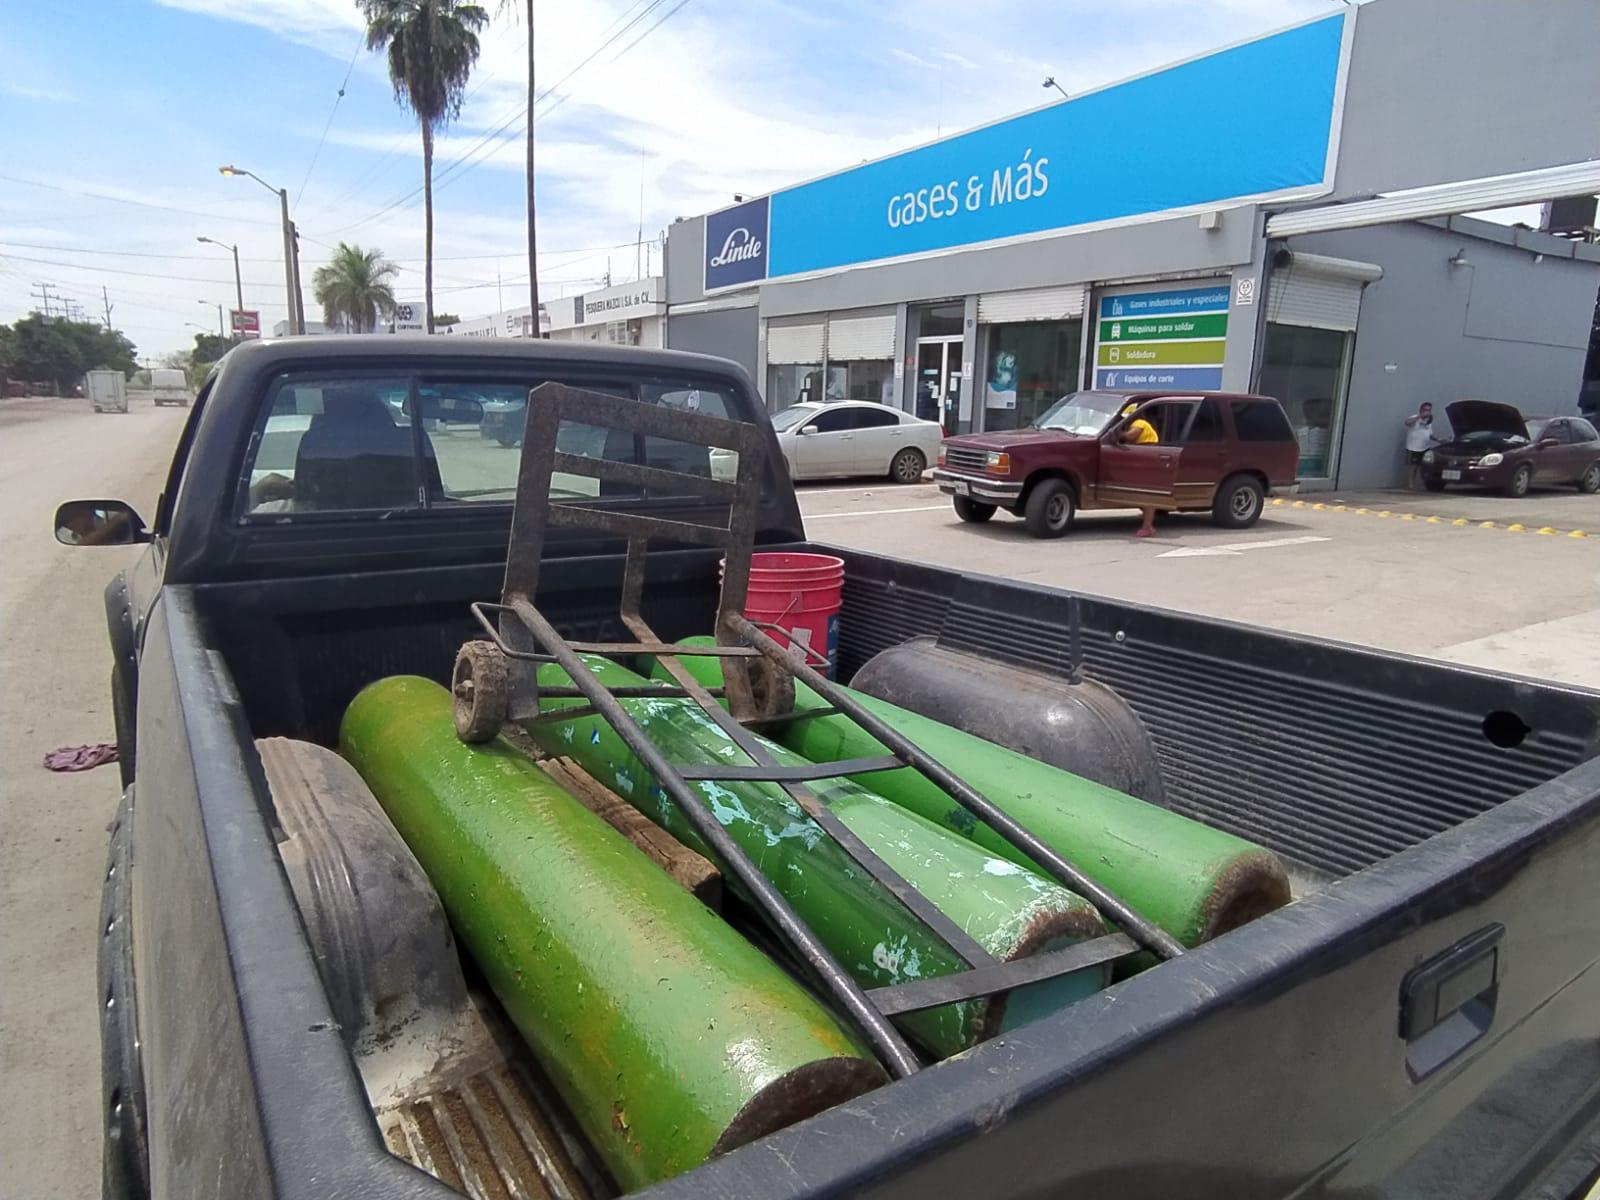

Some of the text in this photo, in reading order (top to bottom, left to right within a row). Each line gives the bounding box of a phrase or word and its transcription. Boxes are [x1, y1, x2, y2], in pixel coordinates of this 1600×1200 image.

[965, 176, 984, 212] &
[989, 148, 1049, 207] Más
[710, 227, 762, 268] Linde
[1129, 300, 1147, 309] Gases
[1149, 297, 1185, 308] industriales
[1192, 293, 1228, 305] especiales
[1128, 322, 1195, 335] Máquinas para soldar
[1124, 374, 1174, 384] Equipos de corte
